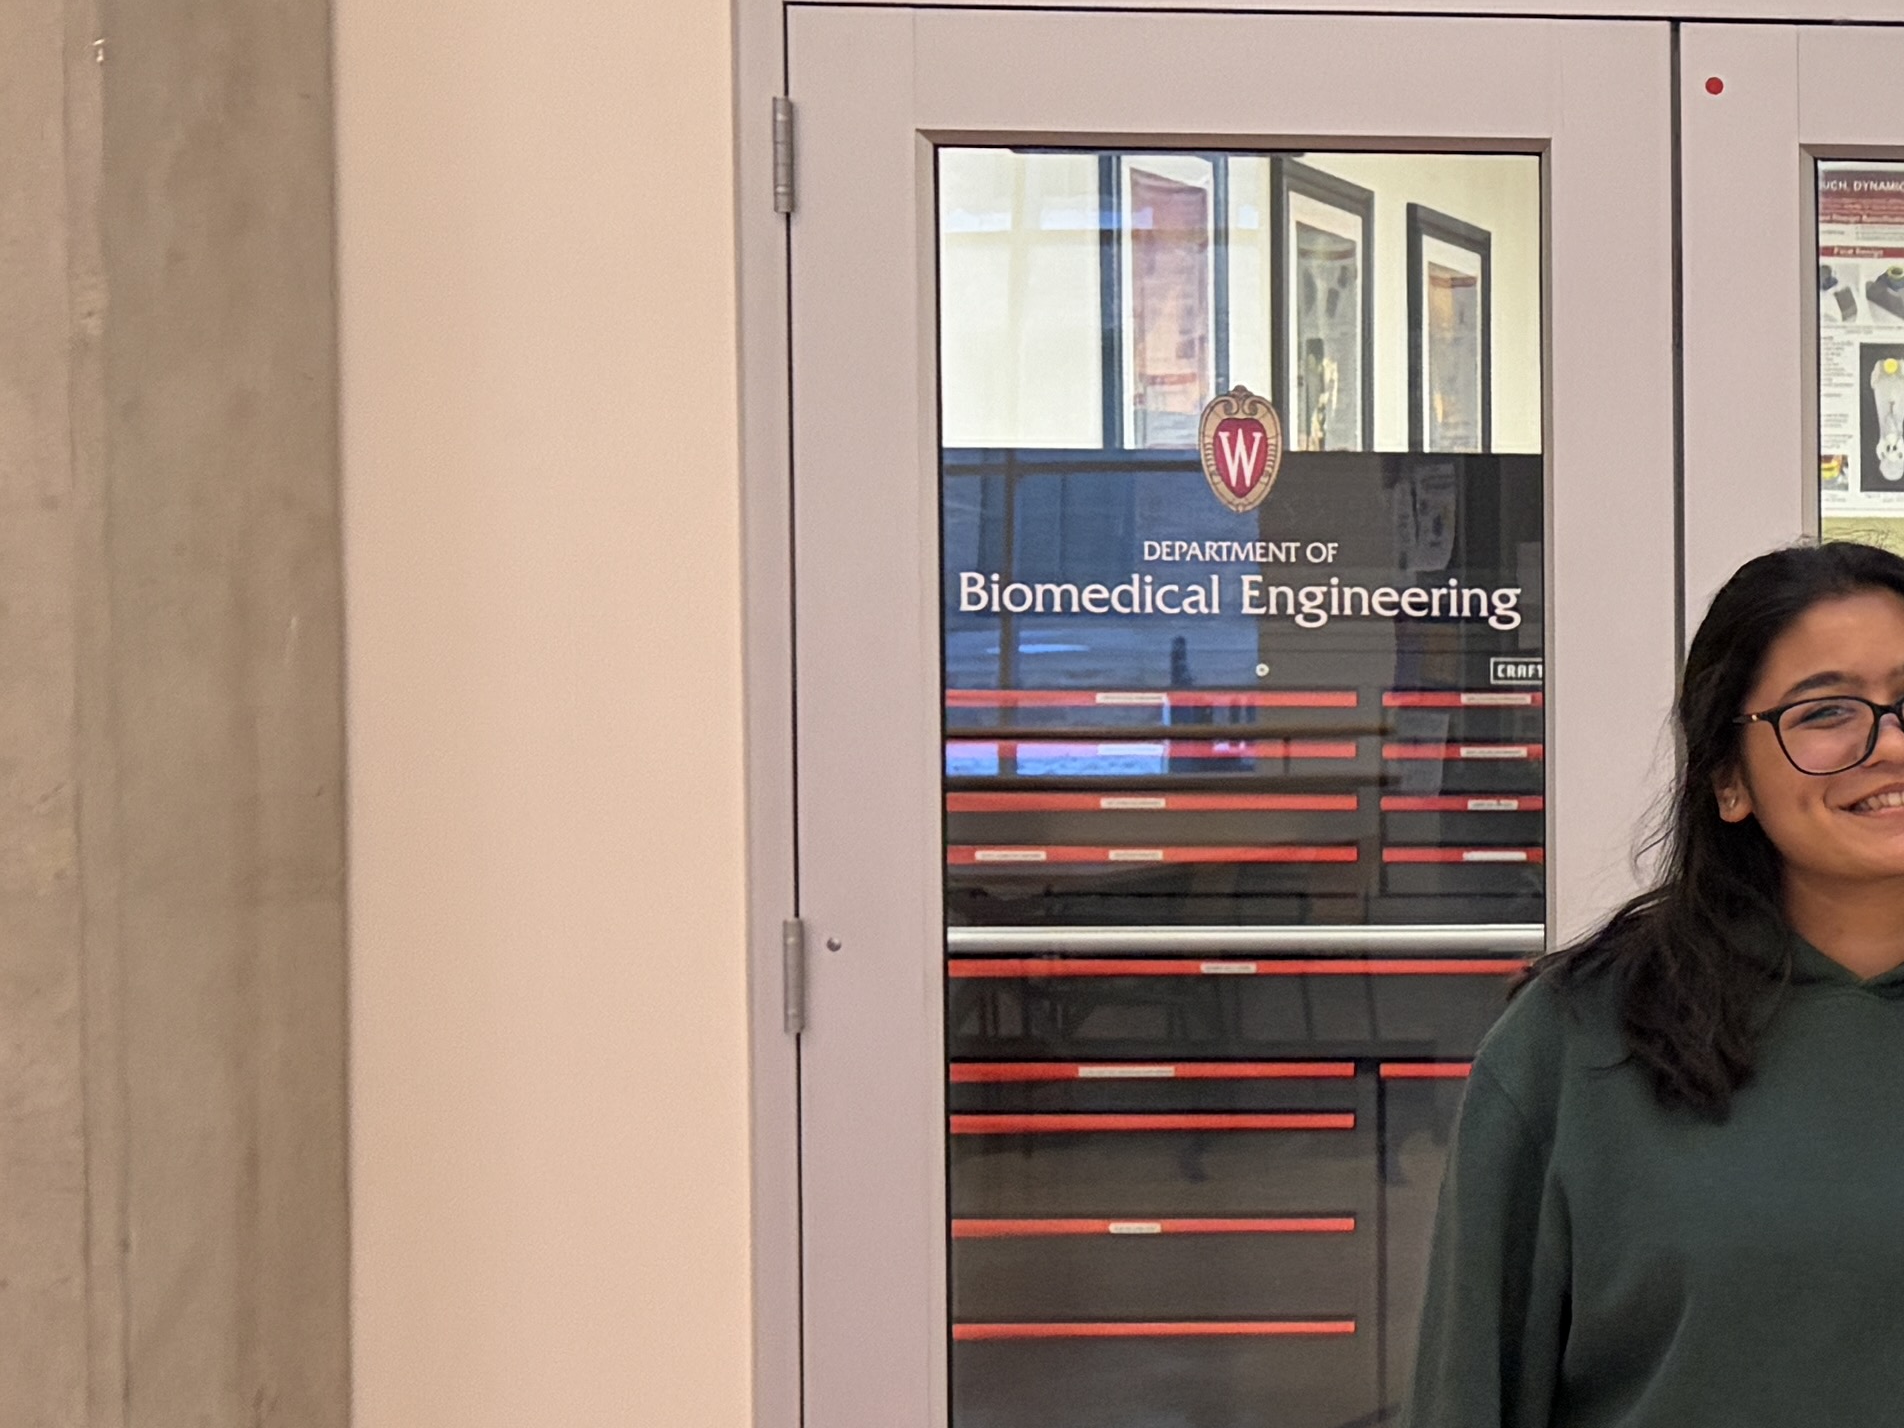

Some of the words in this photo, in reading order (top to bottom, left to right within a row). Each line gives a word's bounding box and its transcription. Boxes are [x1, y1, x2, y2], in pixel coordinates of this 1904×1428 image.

[1218, 430, 1262, 487] W
[1143, 542, 1301, 563] DEPARTMENT
[1305, 542, 1339, 563] OF
[958, 571, 1220, 614] Biomedical
[1240, 574, 1521, 629] Engineering
